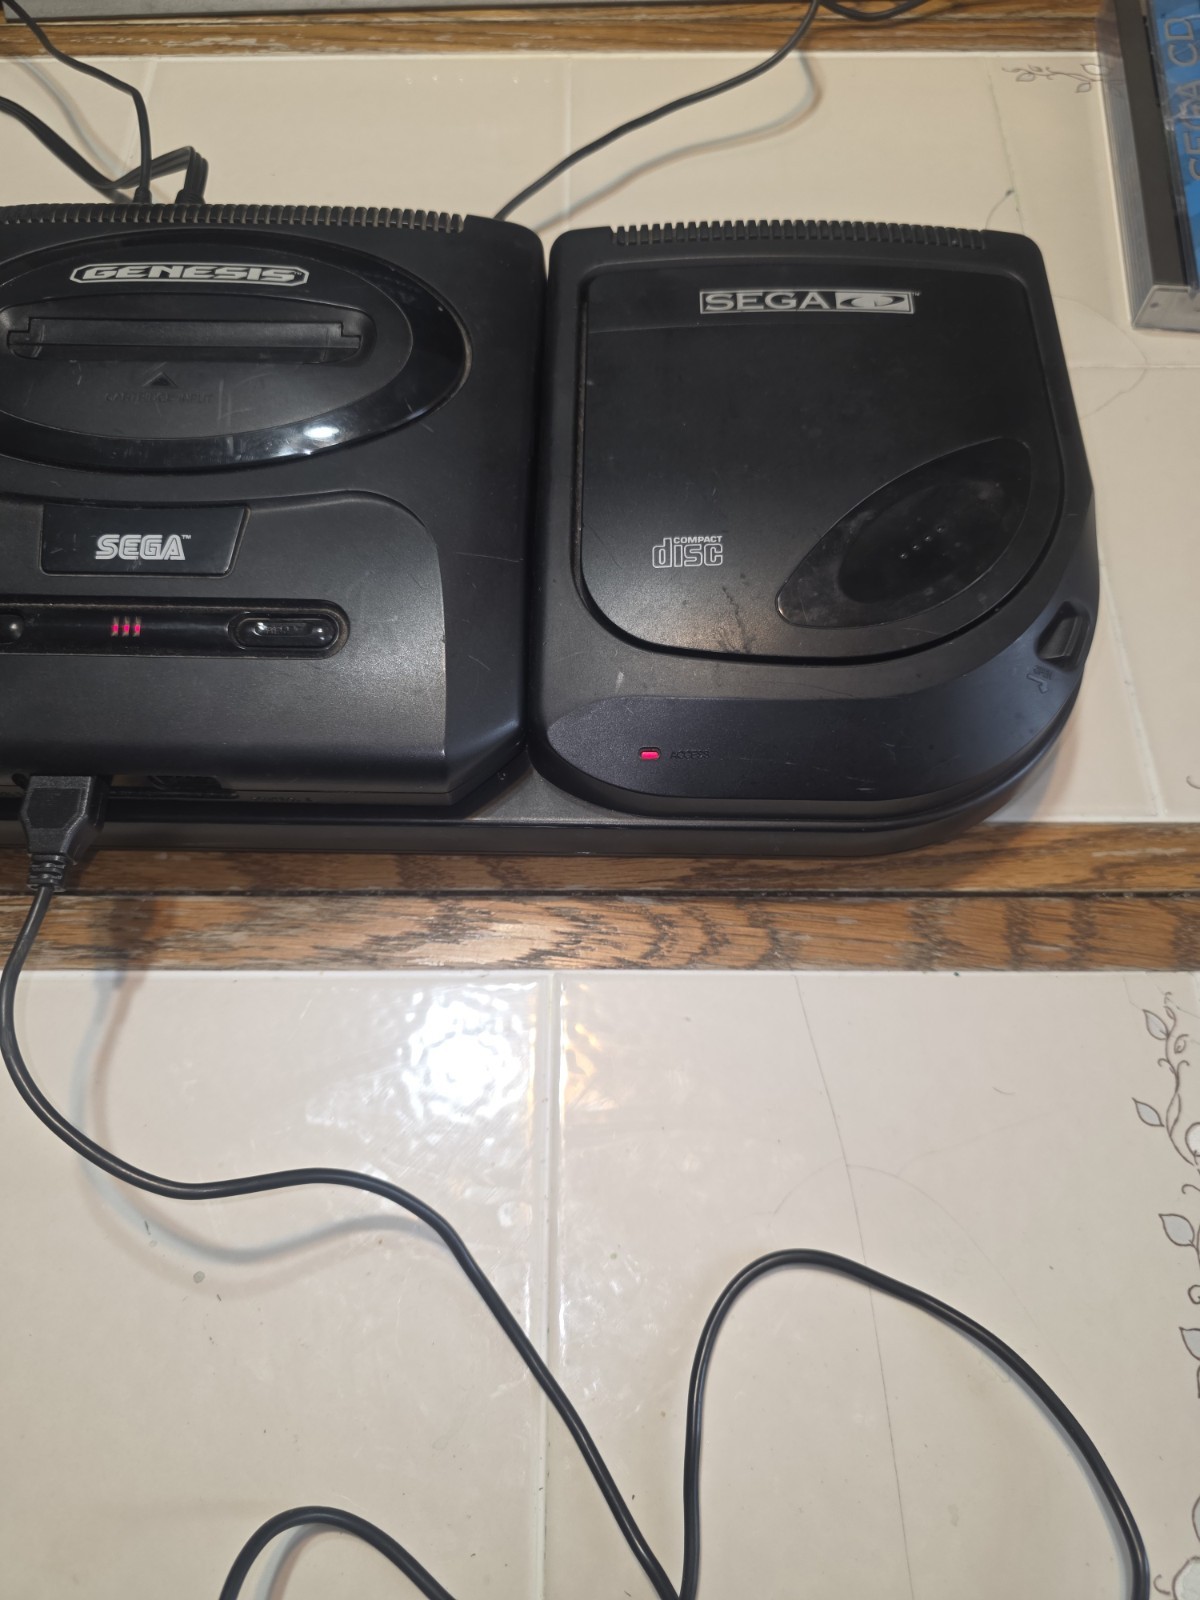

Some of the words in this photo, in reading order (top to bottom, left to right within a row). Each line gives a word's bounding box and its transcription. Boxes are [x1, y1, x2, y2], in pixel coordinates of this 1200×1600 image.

[1165, 17, 1198, 67] CD
[82, 265, 297, 283] GENESIS
[705, 292, 831, 311] SEGA
[95, 534, 186, 560] SEGA
[673, 535, 723, 544] COMPACT
